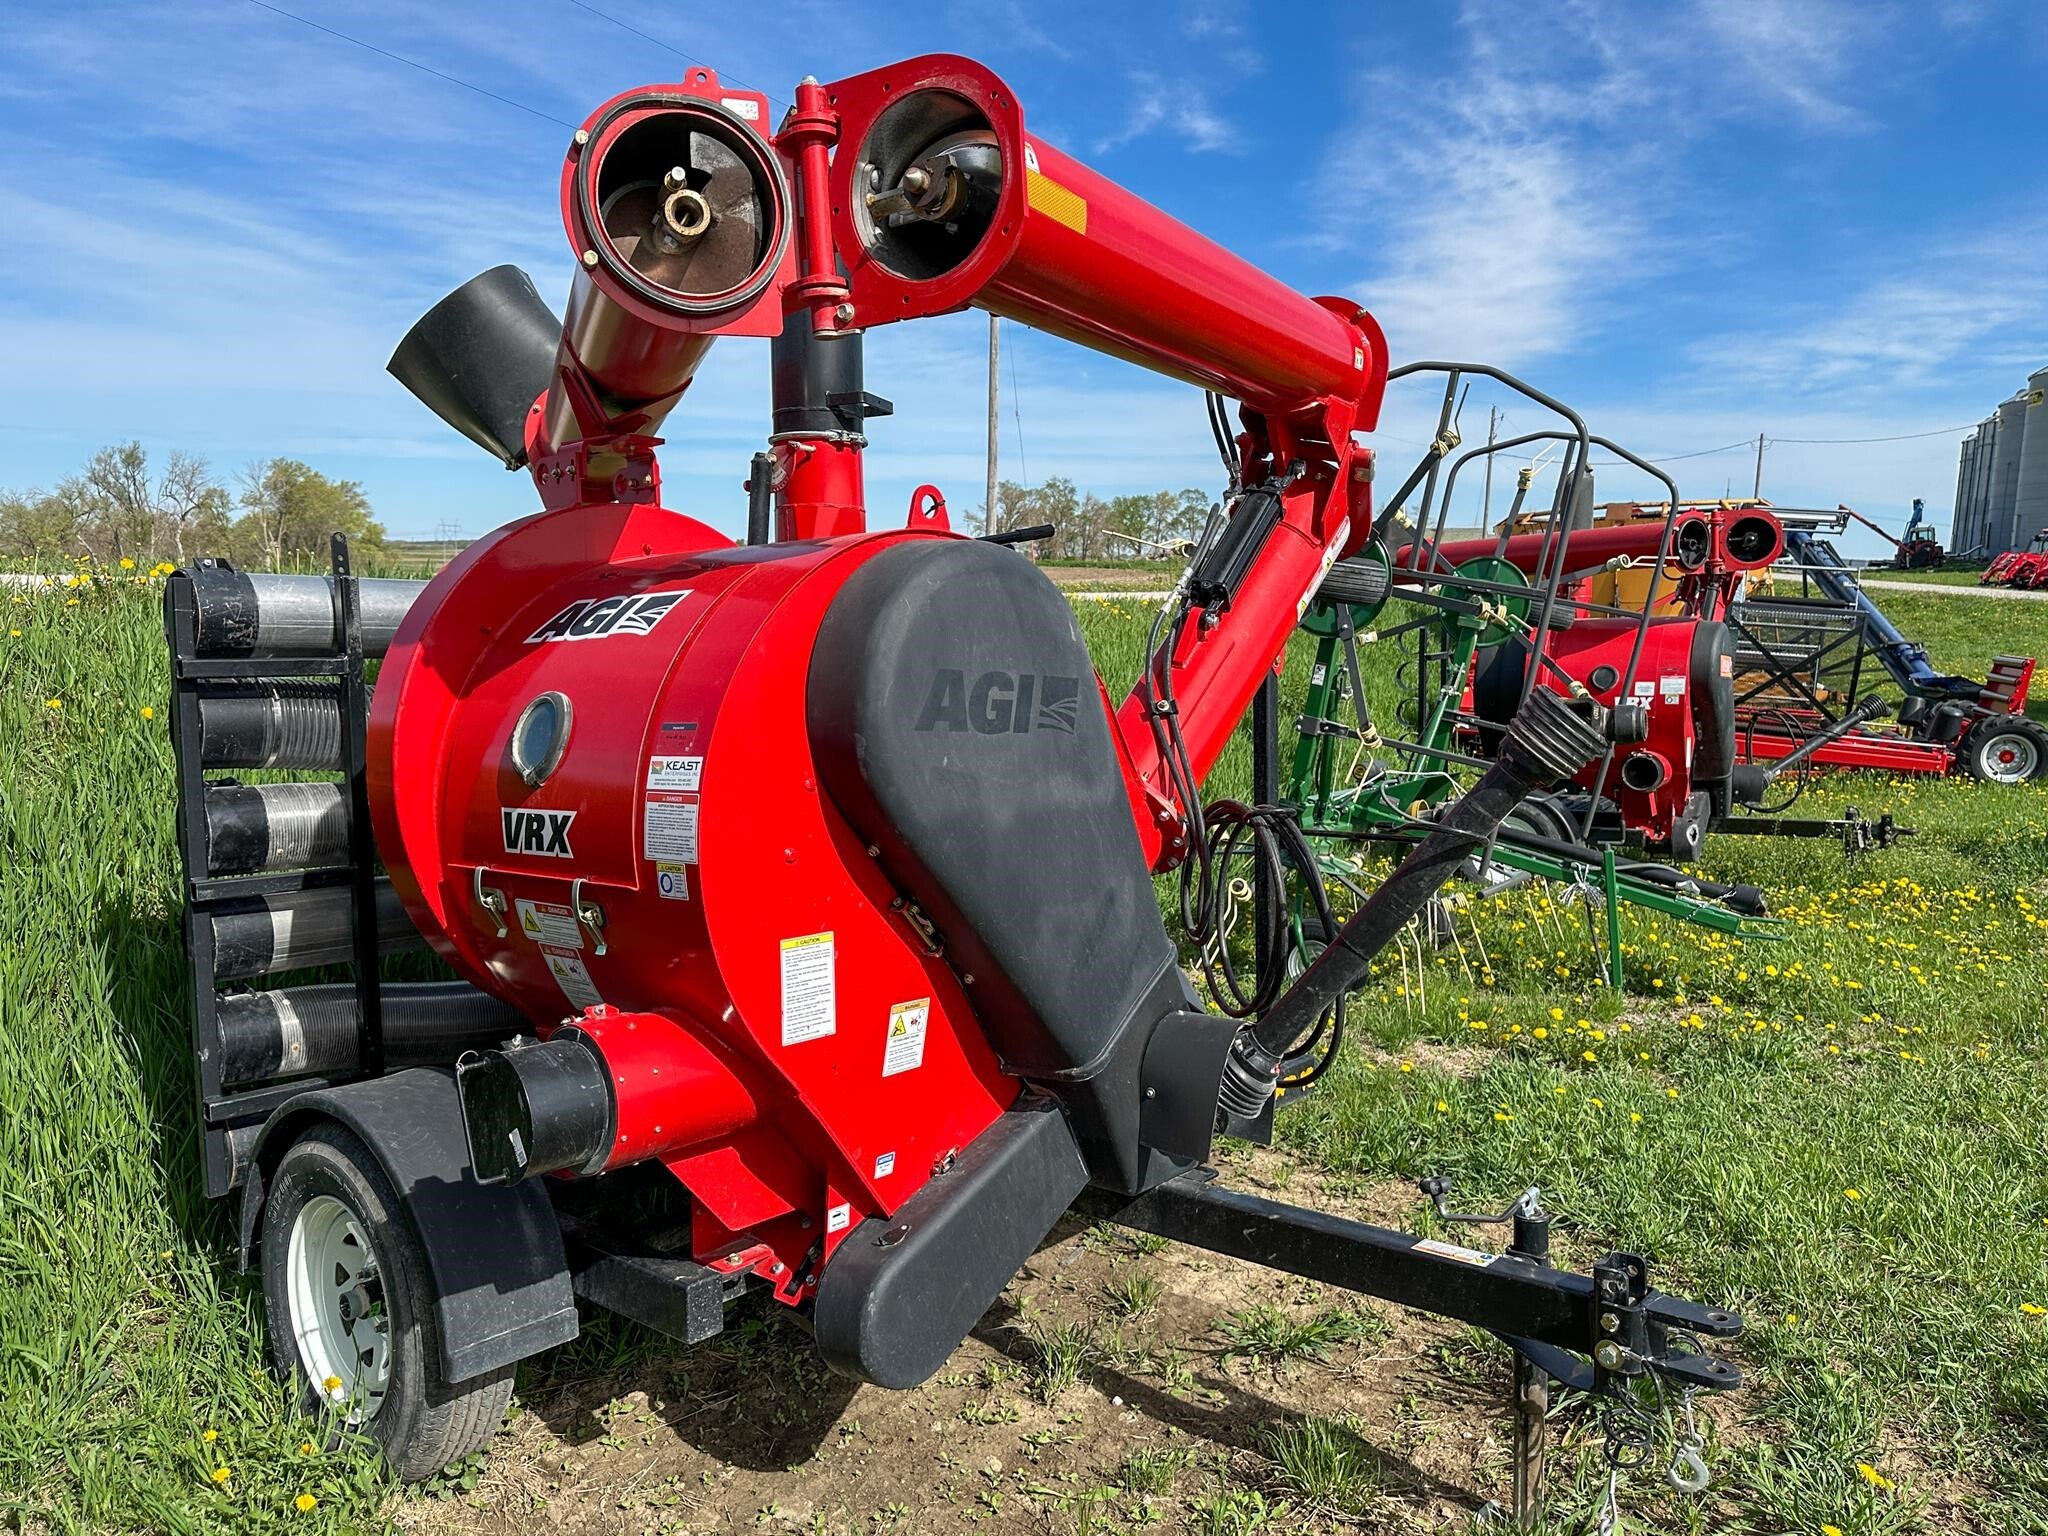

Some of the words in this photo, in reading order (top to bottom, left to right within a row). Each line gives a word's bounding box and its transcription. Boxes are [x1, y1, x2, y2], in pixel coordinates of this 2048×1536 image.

[531, 597, 643, 637] AGI
[914, 669, 1034, 735] AGI
[665, 761, 700, 771] KEAST
[503, 811, 572, 855] VRX
[547, 906, 569, 915] DANGER
[800, 937, 820, 945] CAUTION
